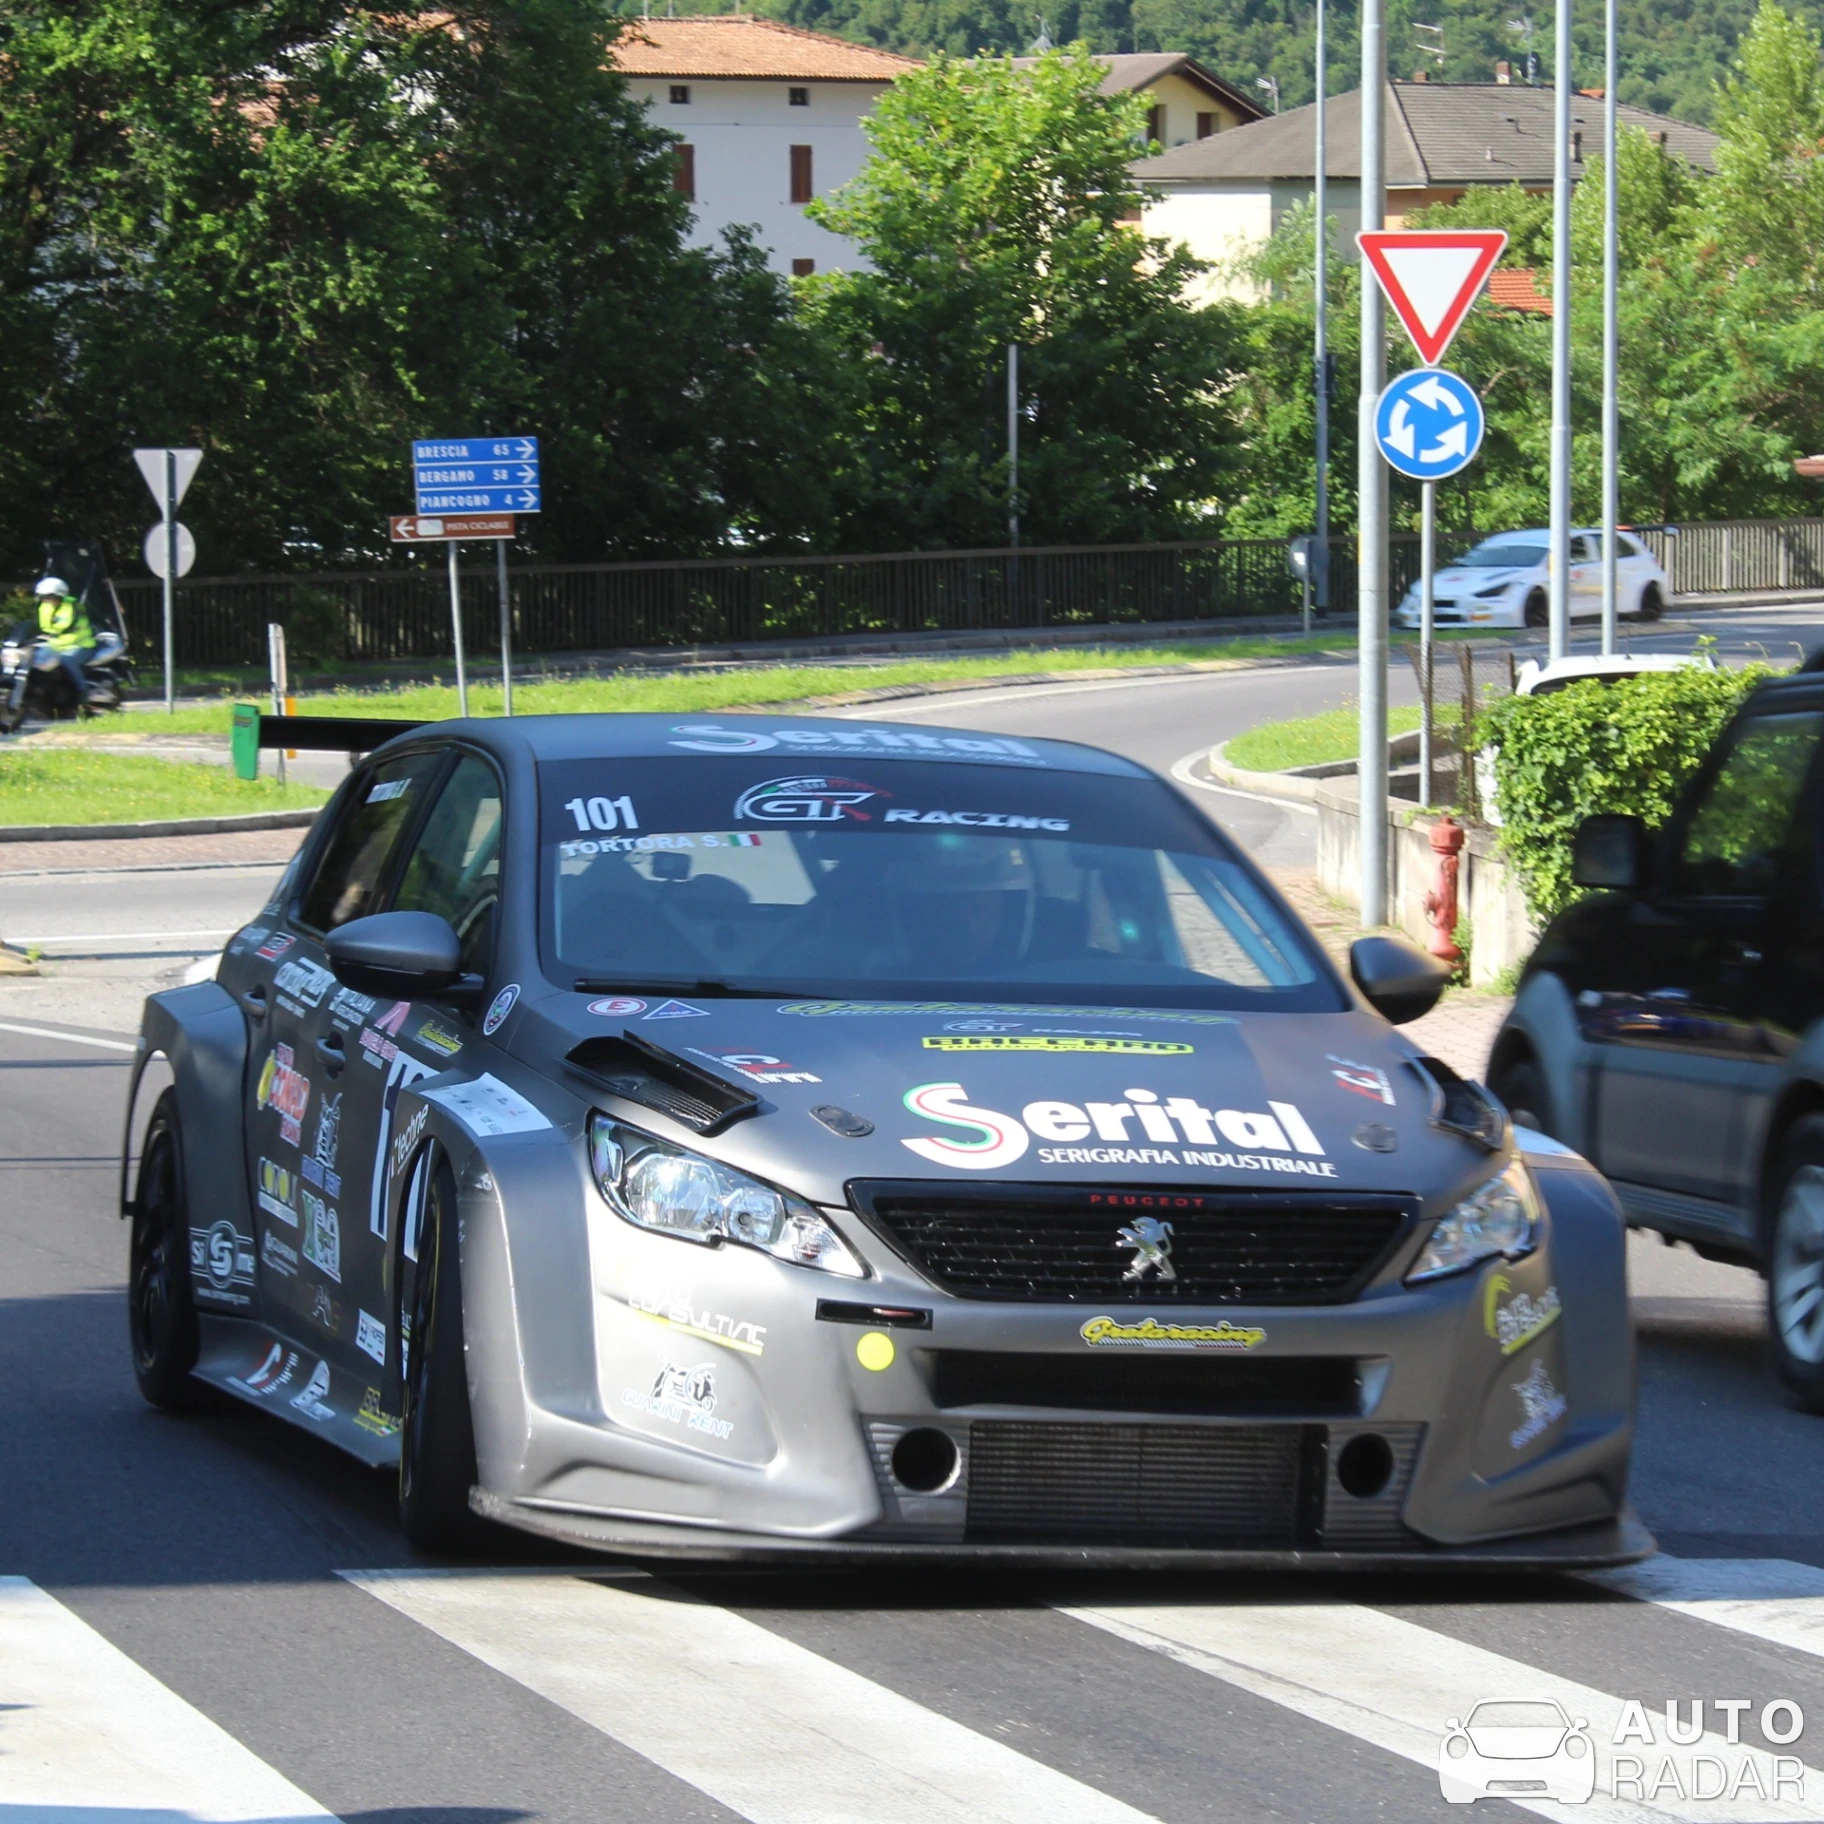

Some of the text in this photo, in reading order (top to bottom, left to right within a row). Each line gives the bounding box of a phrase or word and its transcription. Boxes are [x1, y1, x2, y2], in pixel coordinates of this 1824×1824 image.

[417, 444, 509, 458] BRESCIA 65
[418, 469, 509, 483] BERGAMO 58
[420, 494, 513, 508] PIANCOGNO 4
[667, 725, 1040, 759] Serital
[565, 795, 635, 832] 101
[883, 808, 1071, 832] RACING
[560, 833, 730, 859] TORTORA S.
[900, 1082, 1325, 1170] Serital
[1038, 1147, 1338, 1179] SERIGRAFIA INDUSTRIALE
[1089, 1194, 1205, 1207] PEUGEOT
[621, 1387, 734, 1440] GUARINI RENT
